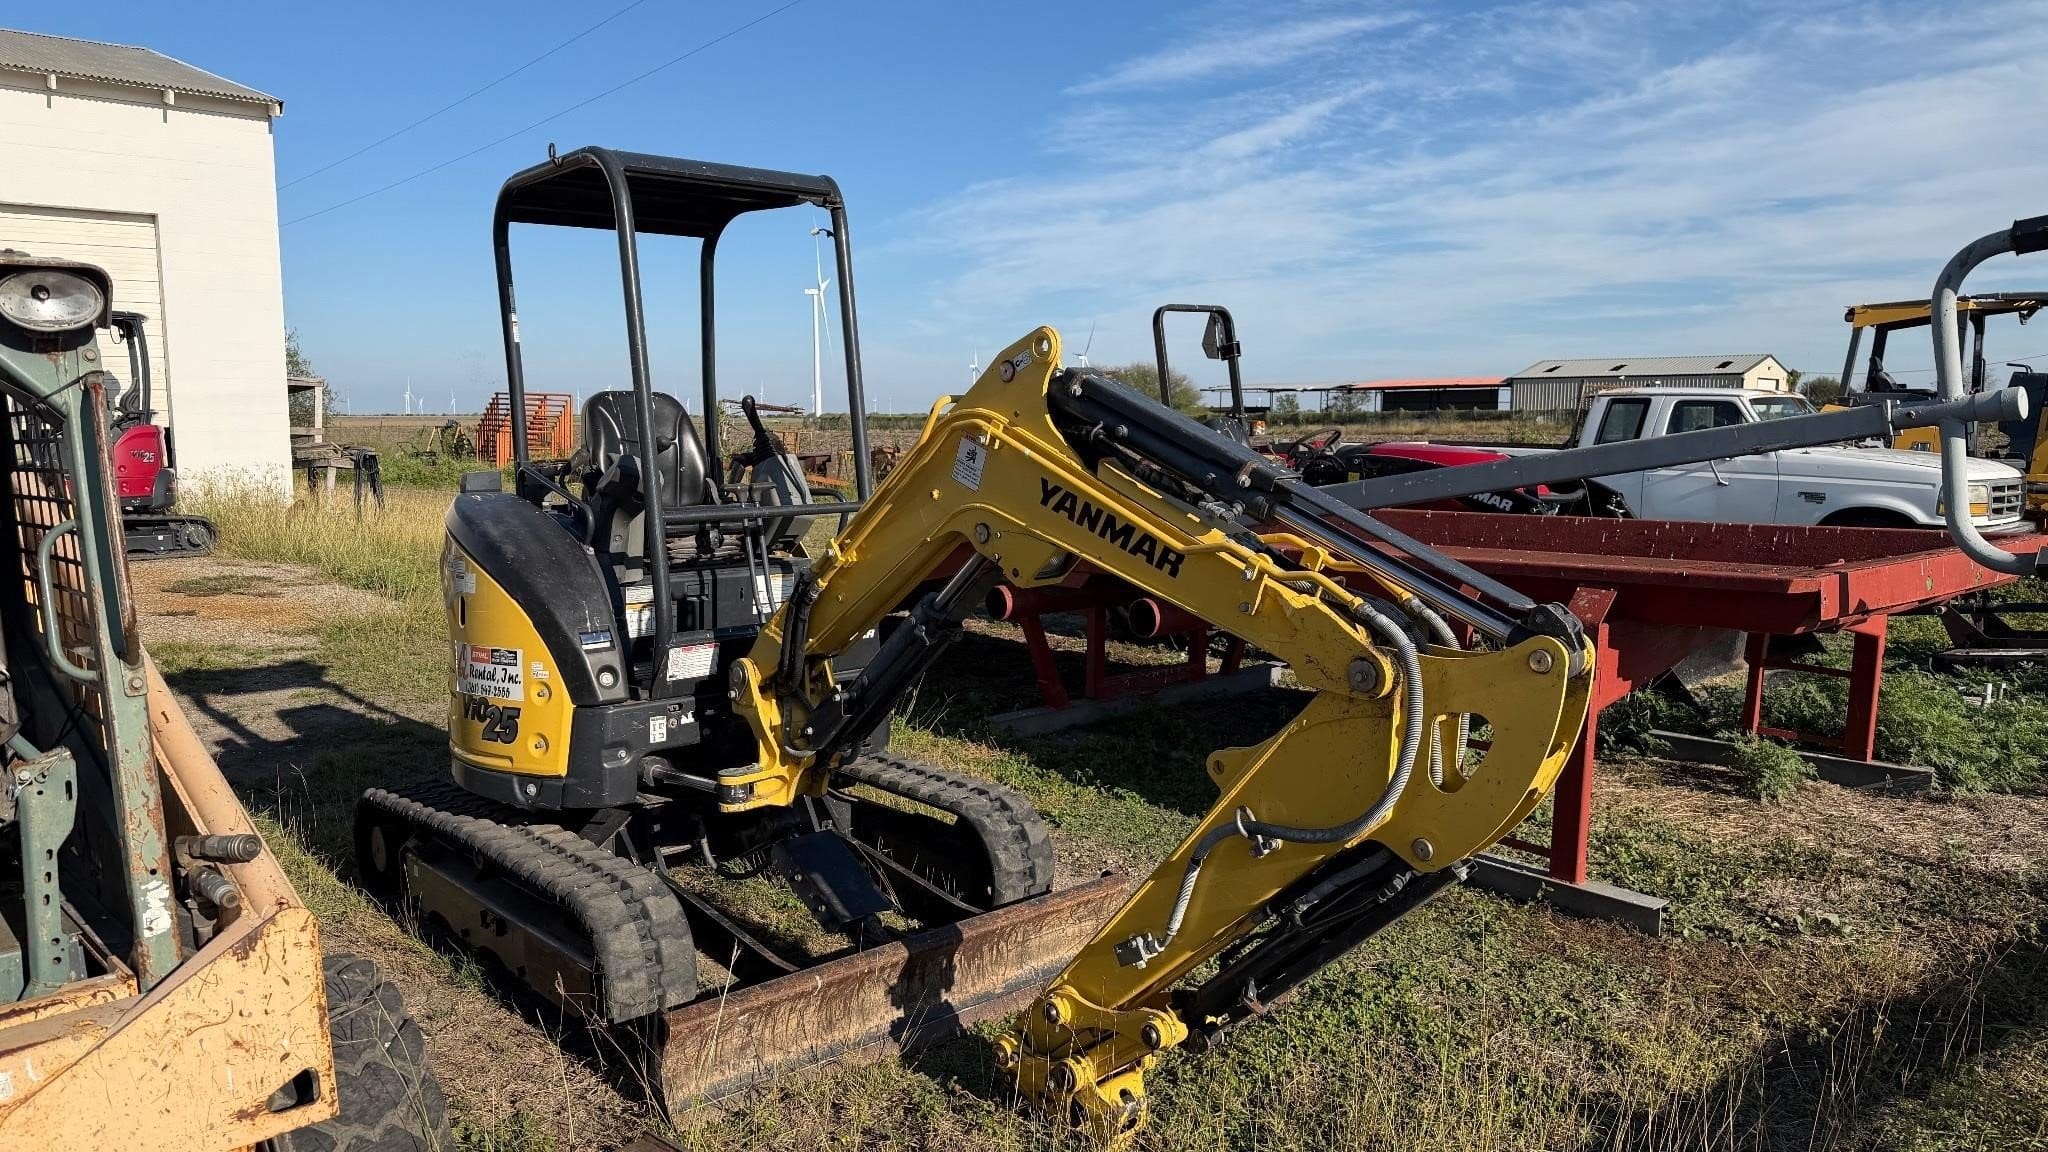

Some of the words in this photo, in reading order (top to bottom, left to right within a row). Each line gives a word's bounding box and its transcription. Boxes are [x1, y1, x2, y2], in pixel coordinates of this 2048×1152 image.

[1468, 492, 1513, 512] MAR
[1040, 477, 1186, 579] YANMAR
[469, 664, 500, 685] Rental,
